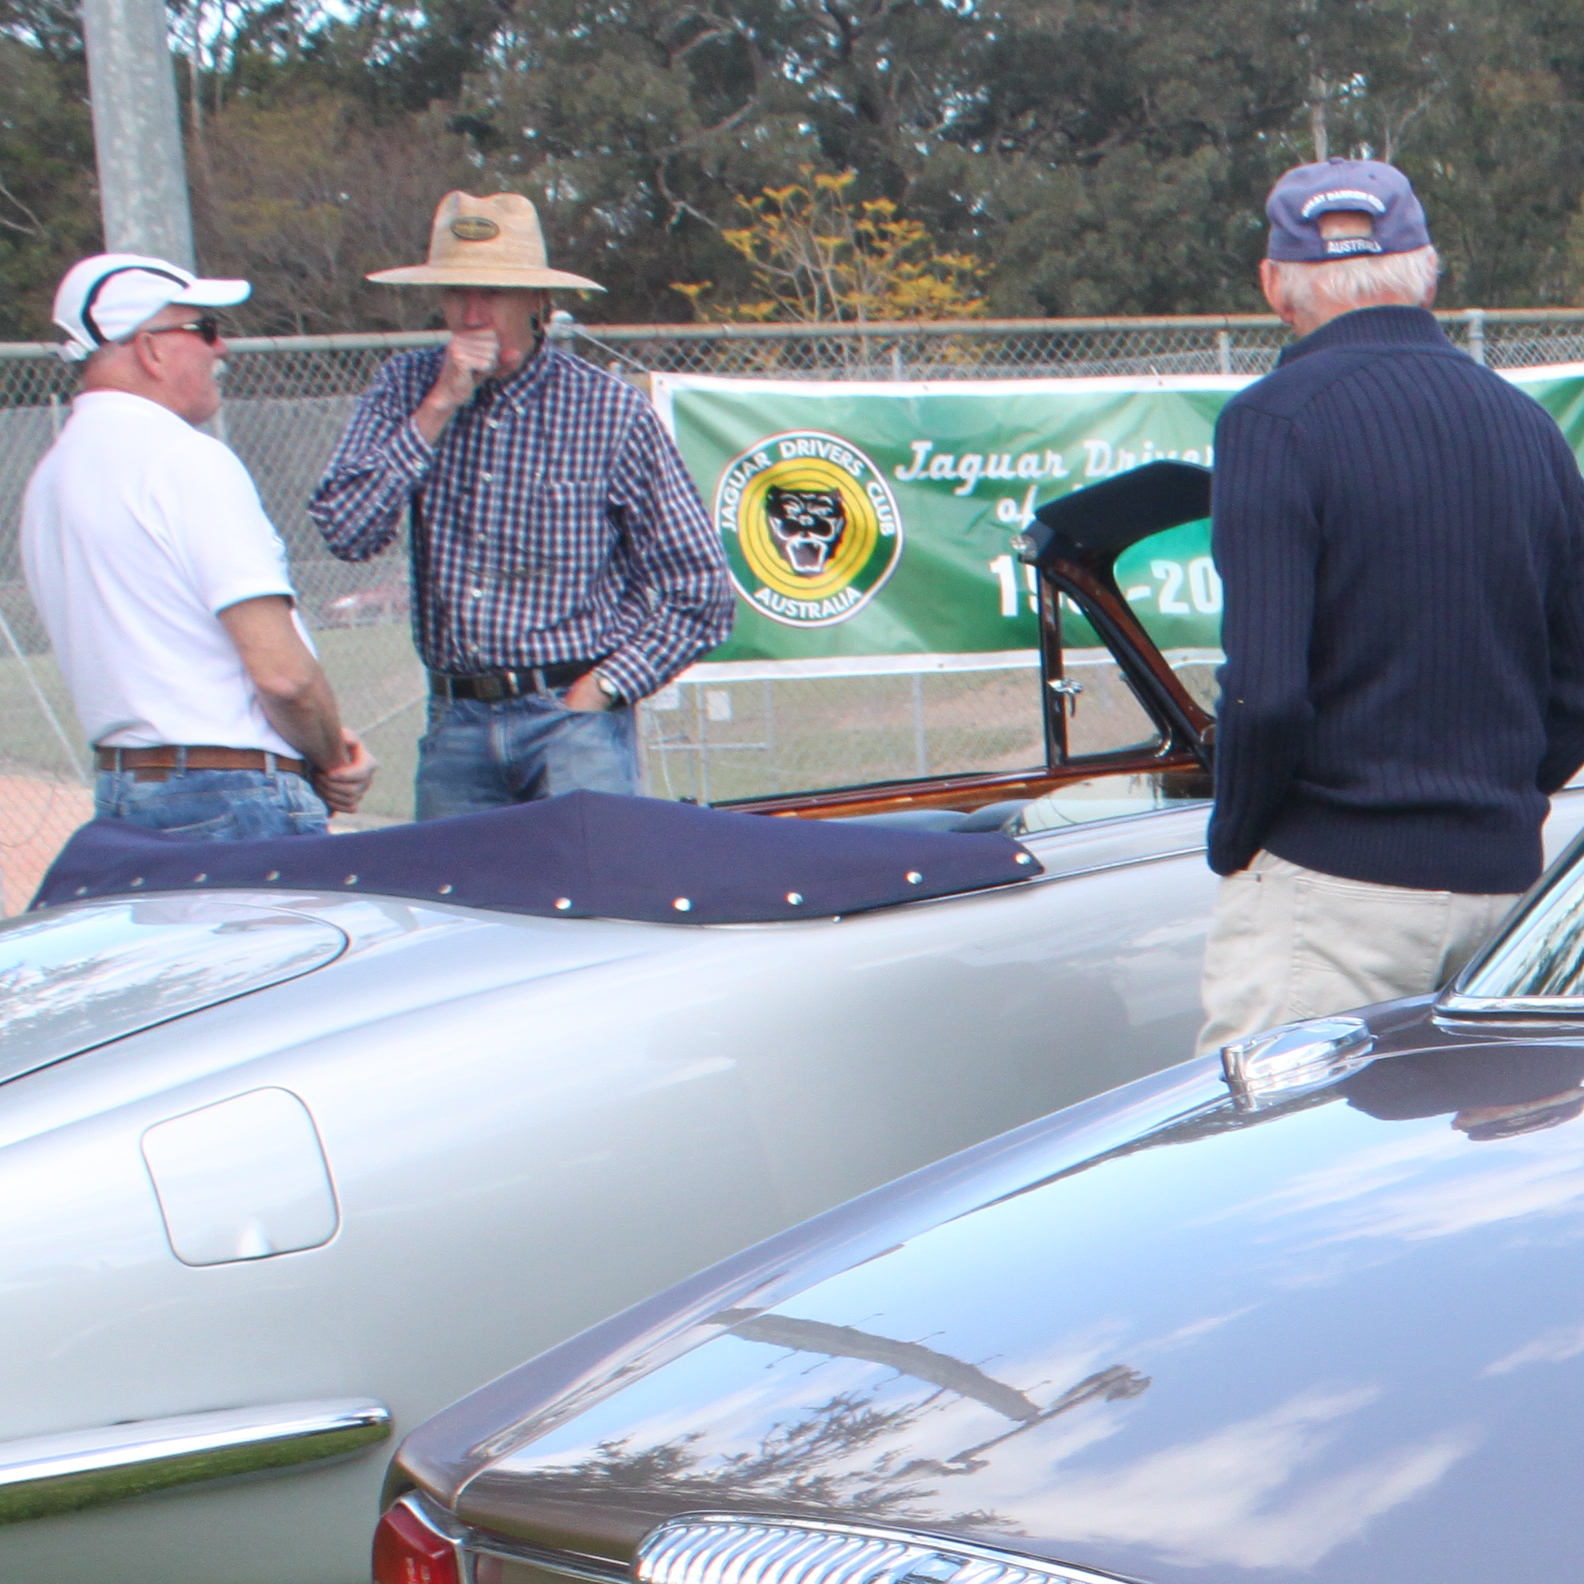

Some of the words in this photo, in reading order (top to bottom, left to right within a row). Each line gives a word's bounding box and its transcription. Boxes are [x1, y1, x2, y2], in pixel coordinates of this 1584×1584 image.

[721, 451, 774, 533] JAGUAR
[779, 438, 865, 478] DRIVERS
[865, 480, 897, 538] CLUB
[893, 440, 1070, 497] Jaguar
[753, 586, 864, 620] AUSTRALIA
